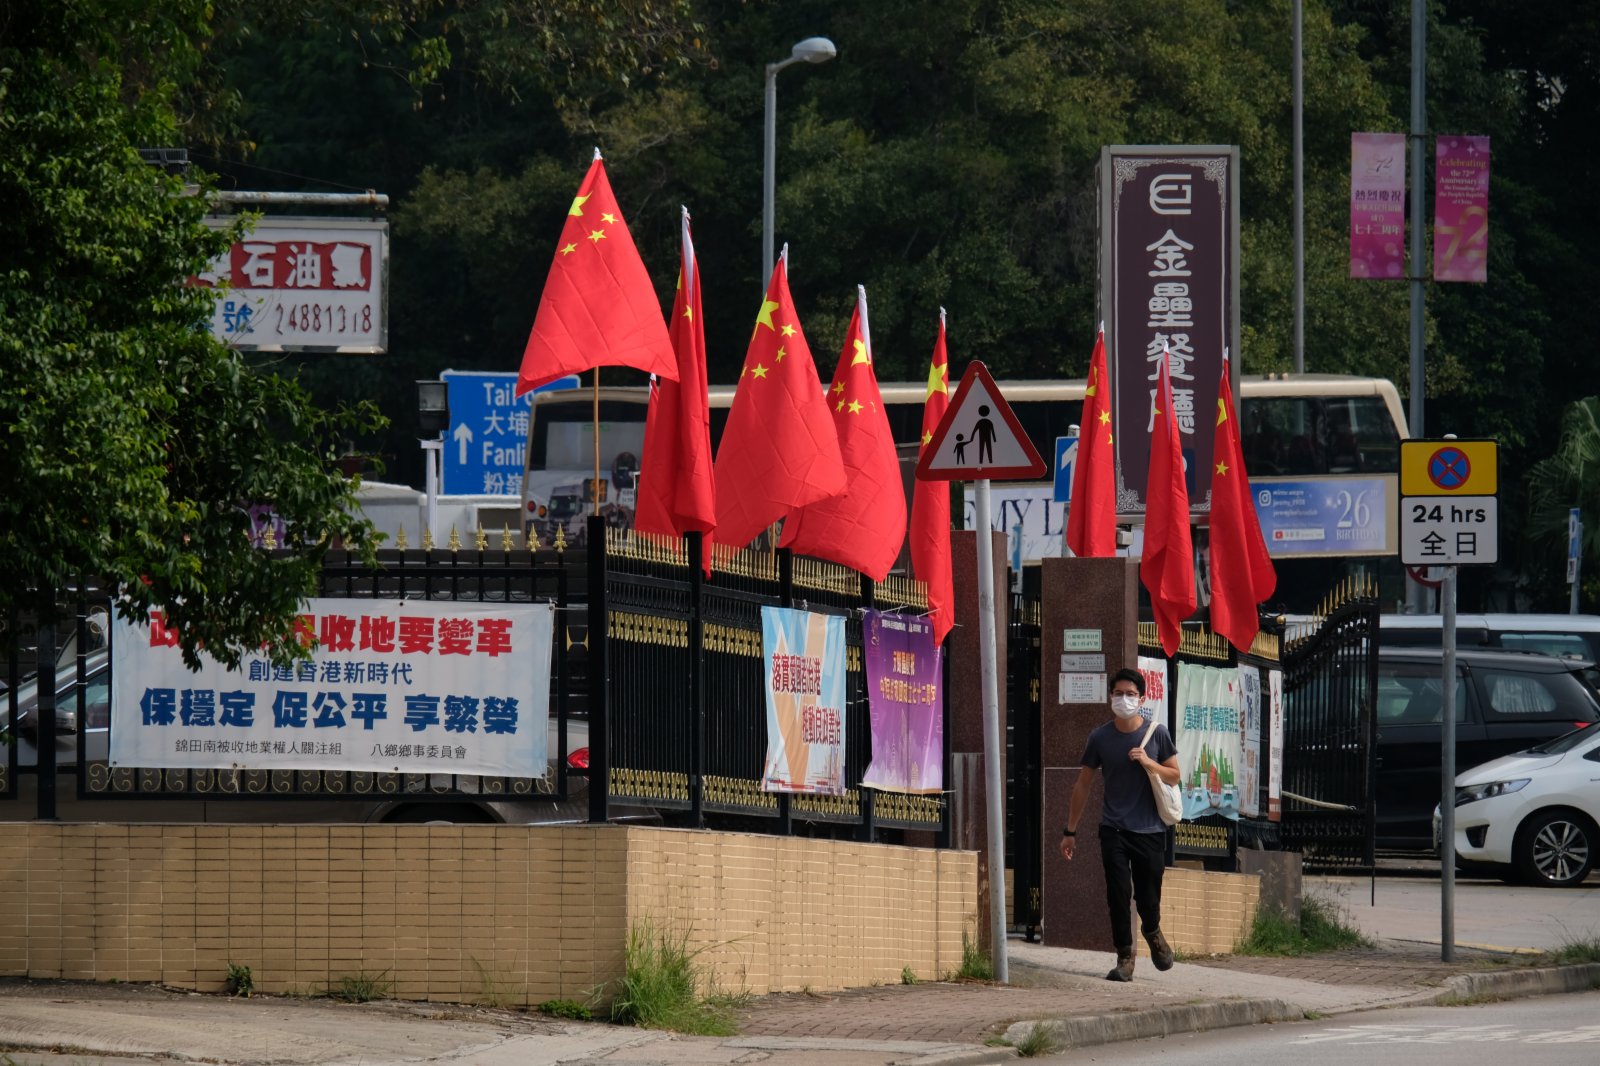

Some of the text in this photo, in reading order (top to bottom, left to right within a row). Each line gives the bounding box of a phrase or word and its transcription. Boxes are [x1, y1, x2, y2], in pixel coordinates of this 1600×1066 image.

[1439, 158, 1487, 168] Celebrating
[205, 243, 367, 288] 石油氣
[275, 303, 372, 335] 24881318
[483, 382, 511, 407] Tai
[483, 409, 530, 437] 大埔
[1336, 489, 1370, 528] 26
[1412, 504, 1486, 524] 24 hrs
[1420, 531, 1477, 556] 全日
[249, 658, 413, 685] 創建香港新時代
[140, 688, 519, 735] 保穩定 促公平 享繁榮
[175, 739, 467, 759] 錦田南被收地業權人關注組 八鄉鄉事委員會
